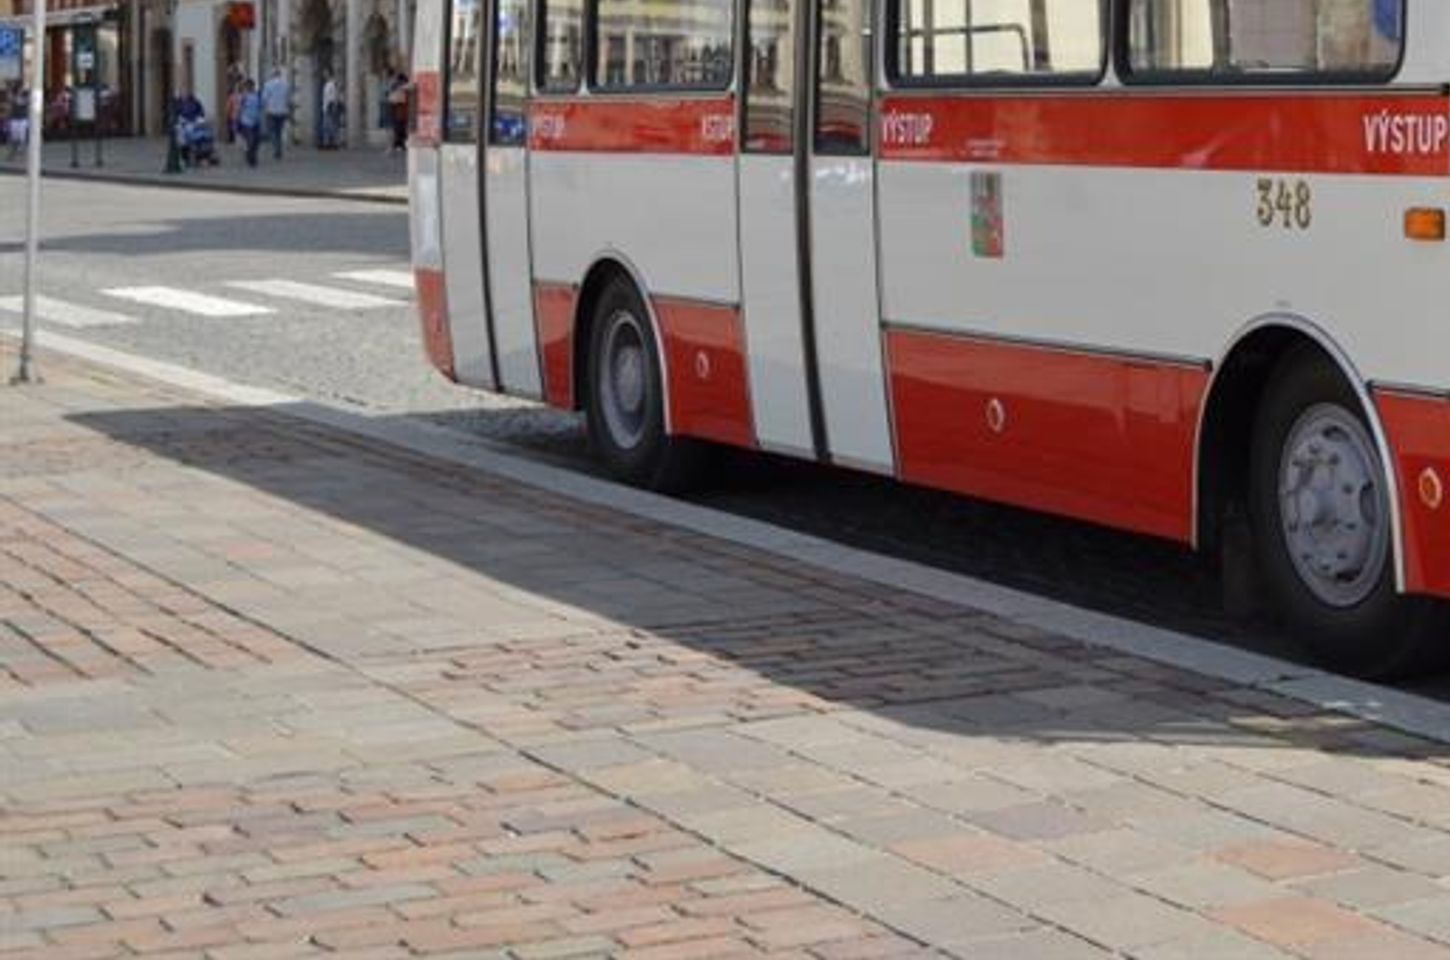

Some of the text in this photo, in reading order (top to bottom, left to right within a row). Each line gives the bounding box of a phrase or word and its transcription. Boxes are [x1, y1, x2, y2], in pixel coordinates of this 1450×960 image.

[882, 108, 933, 144] VÝSTUP
[1363, 109, 1449, 152] VÝSTUP
[1257, 179, 1312, 229] 348
